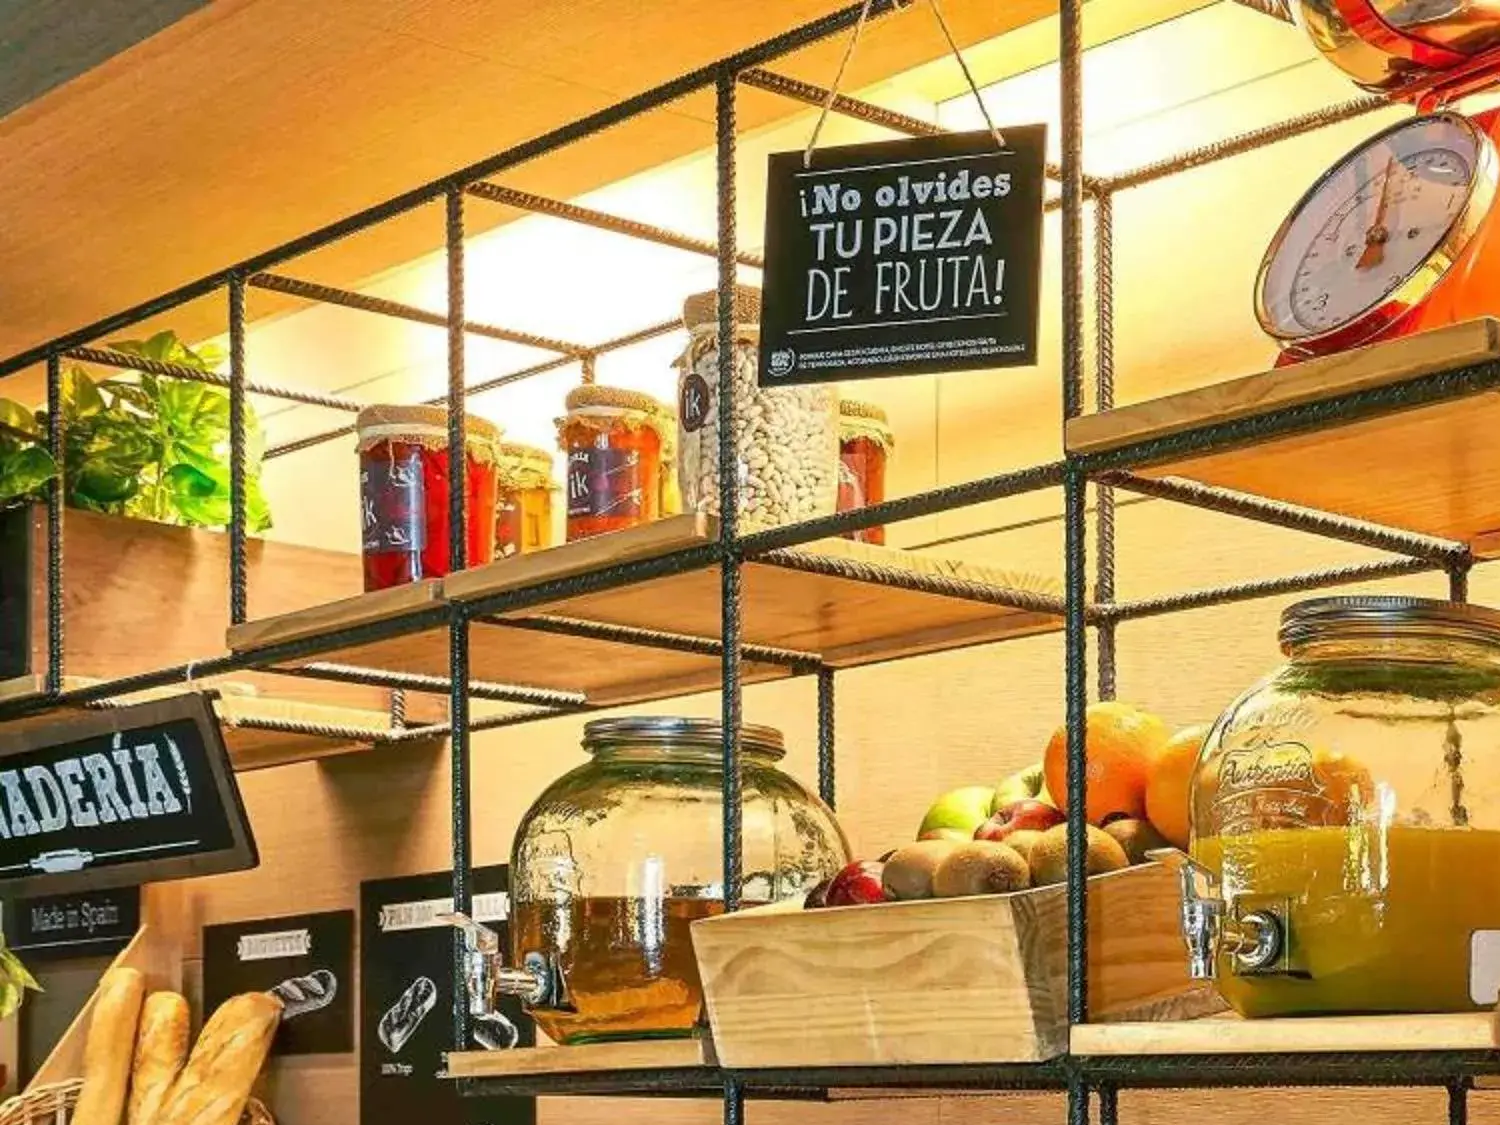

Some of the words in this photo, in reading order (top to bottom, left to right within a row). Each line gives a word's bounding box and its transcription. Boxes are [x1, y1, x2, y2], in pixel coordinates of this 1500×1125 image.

[800, 184, 861, 217] ¡No
[875, 170, 1011, 207] olvides
[810, 219, 863, 260] TU
[873, 208, 993, 254] PIEZA
[805, 267, 853, 321] DE
[874, 254, 1005, 314] FRUTA!
[0, 732, 192, 838] ADERÍA!
